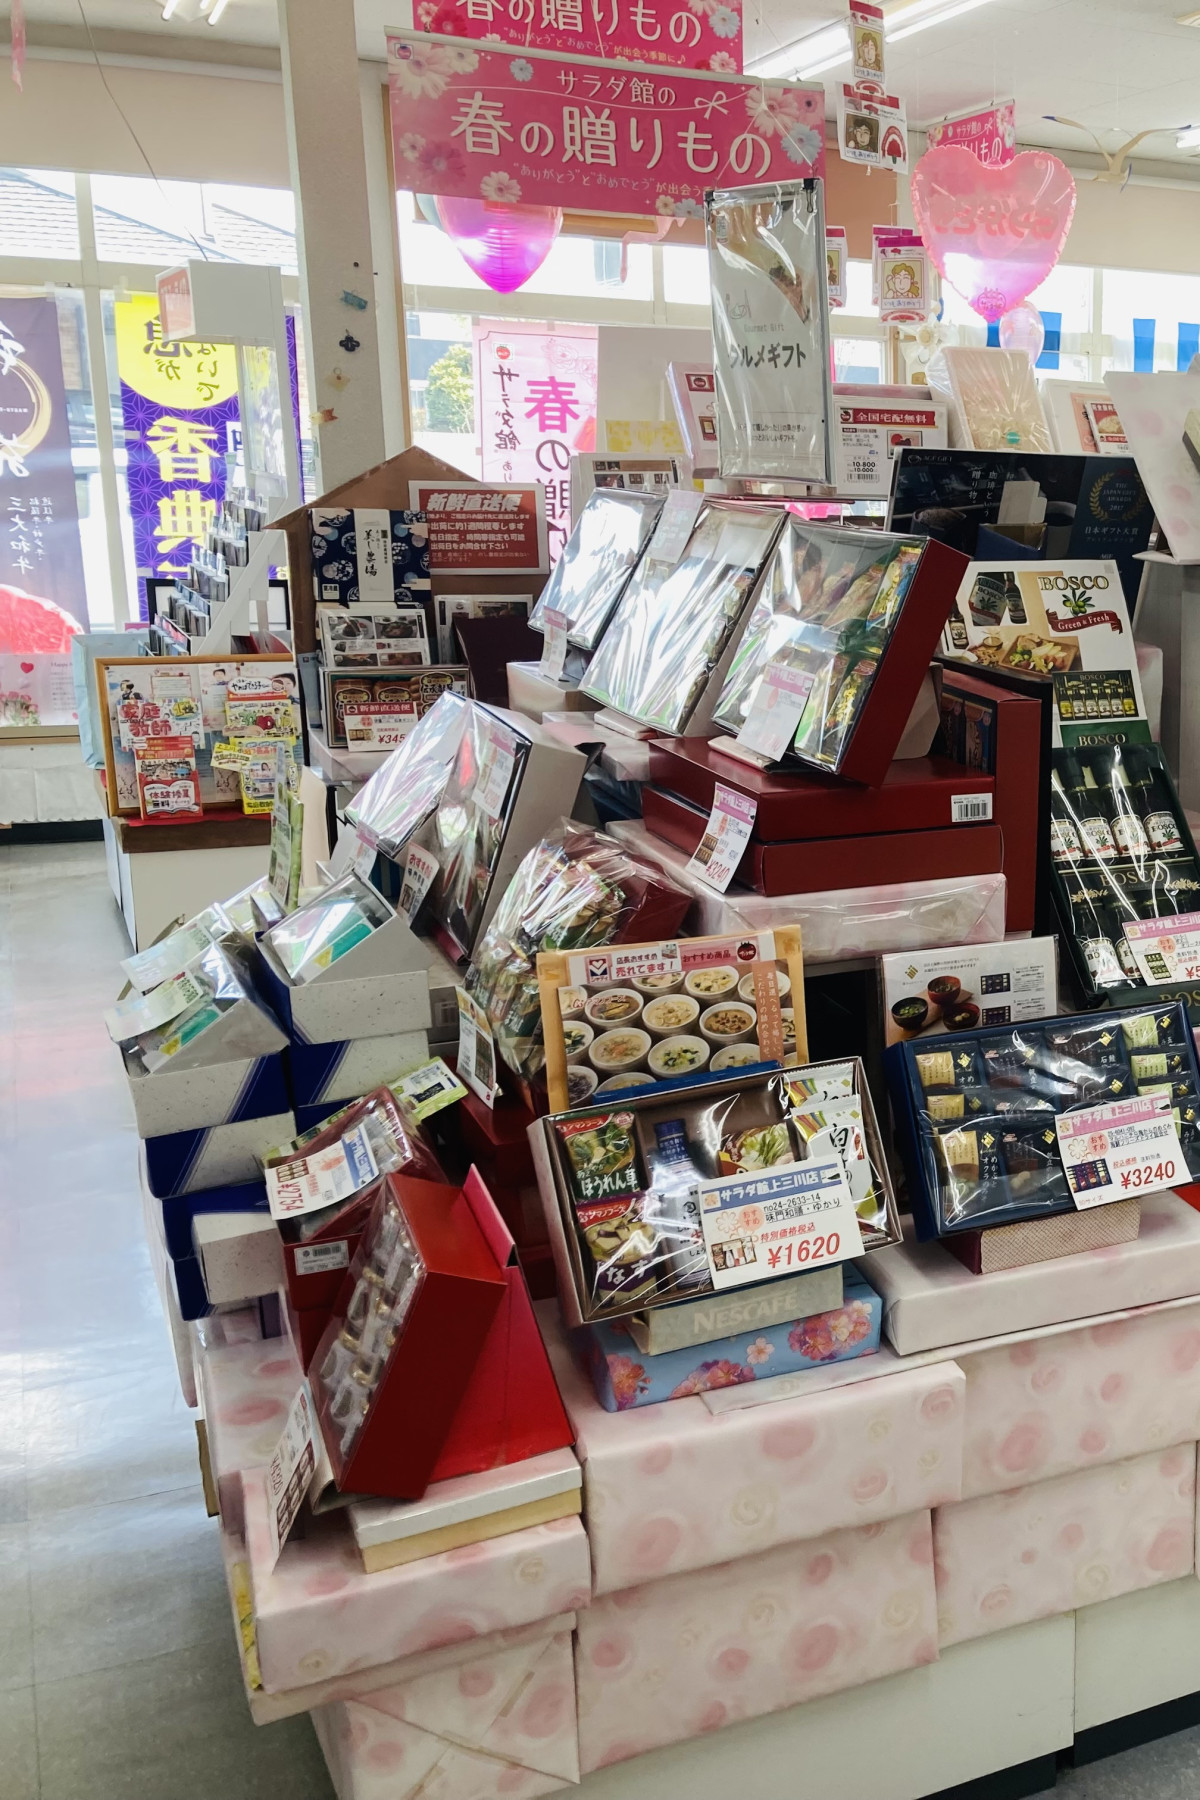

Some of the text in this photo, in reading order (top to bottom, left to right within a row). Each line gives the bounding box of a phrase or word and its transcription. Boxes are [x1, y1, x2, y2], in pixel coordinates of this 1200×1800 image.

[456, 0, 701, 47] 春の贈りもの
[557, 70, 676, 105] サラダ館の
[449, 91, 772, 178] 春の贈りもの
[856, 412, 927, 423] 全国宅配無料
[427, 493, 522, 511] 新鮮直送便
[1085, 527, 1138, 536] 日本ギフト大賞
[1038, 576, 1110, 591] BOSCO
[1057, 613, 1110, 631] Green Fresh
[360, 704, 411, 712] 新鮮直送便
[129, 720, 171, 736] 教師
[1079, 733, 1126, 747] BOSCO
[705, 858, 731, 884] ¥3240
[1099, 868, 1165, 888] BOSCO
[616, 954, 658, 965] 店長おすすめ
[682, 950, 731, 963] おすすめ商品
[616, 961, 674, 978] 売れてます!
[590, 976, 609, 984] シャディ
[582, 1168, 638, 1197] ほうれん草
[1121, 1160, 1175, 1189] ¥3240
[280, 1179, 304, 1213] ¥2754
[720, 1172, 819, 1201] サラダ館上三川店
[764, 1193, 821, 1212] no24-2633-14
[761, 1222, 815, 1241] 特別価格税込
[768, 1233, 841, 1268] ¥1620
[607, 1259, 648, 1284] なす
